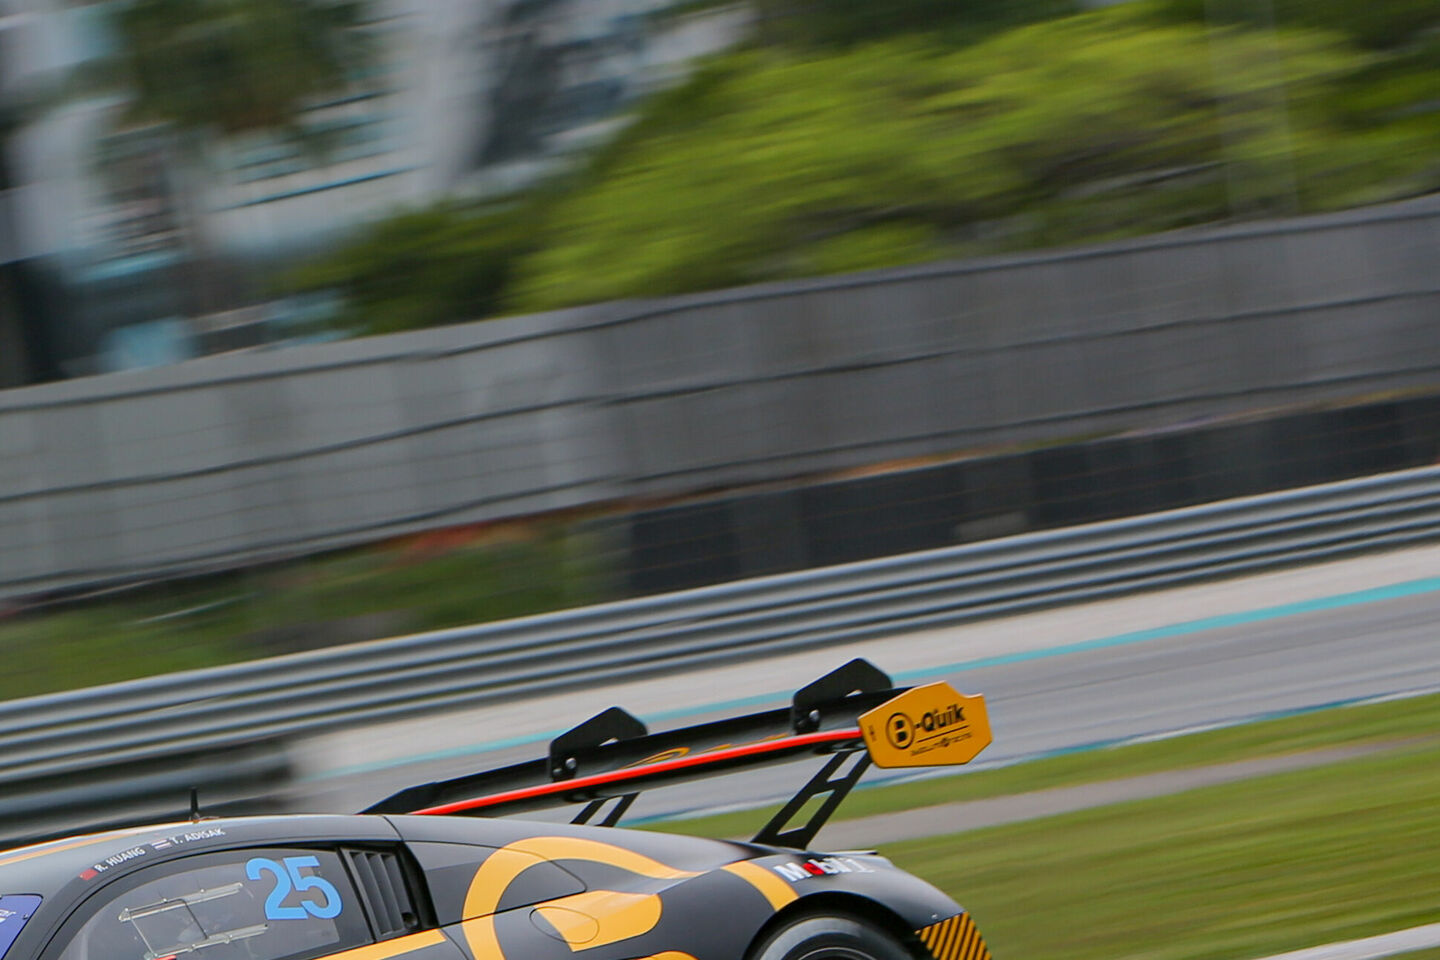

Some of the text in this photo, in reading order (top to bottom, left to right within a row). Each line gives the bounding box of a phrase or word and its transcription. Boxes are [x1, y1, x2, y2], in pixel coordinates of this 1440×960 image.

[886, 704, 966, 750] B-Quik
[185, 828, 226, 842] ADISAK
[94, 846, 146, 873] R. HUANG
[773, 857, 853, 882] Mobil
[246, 855, 343, 920] 25
